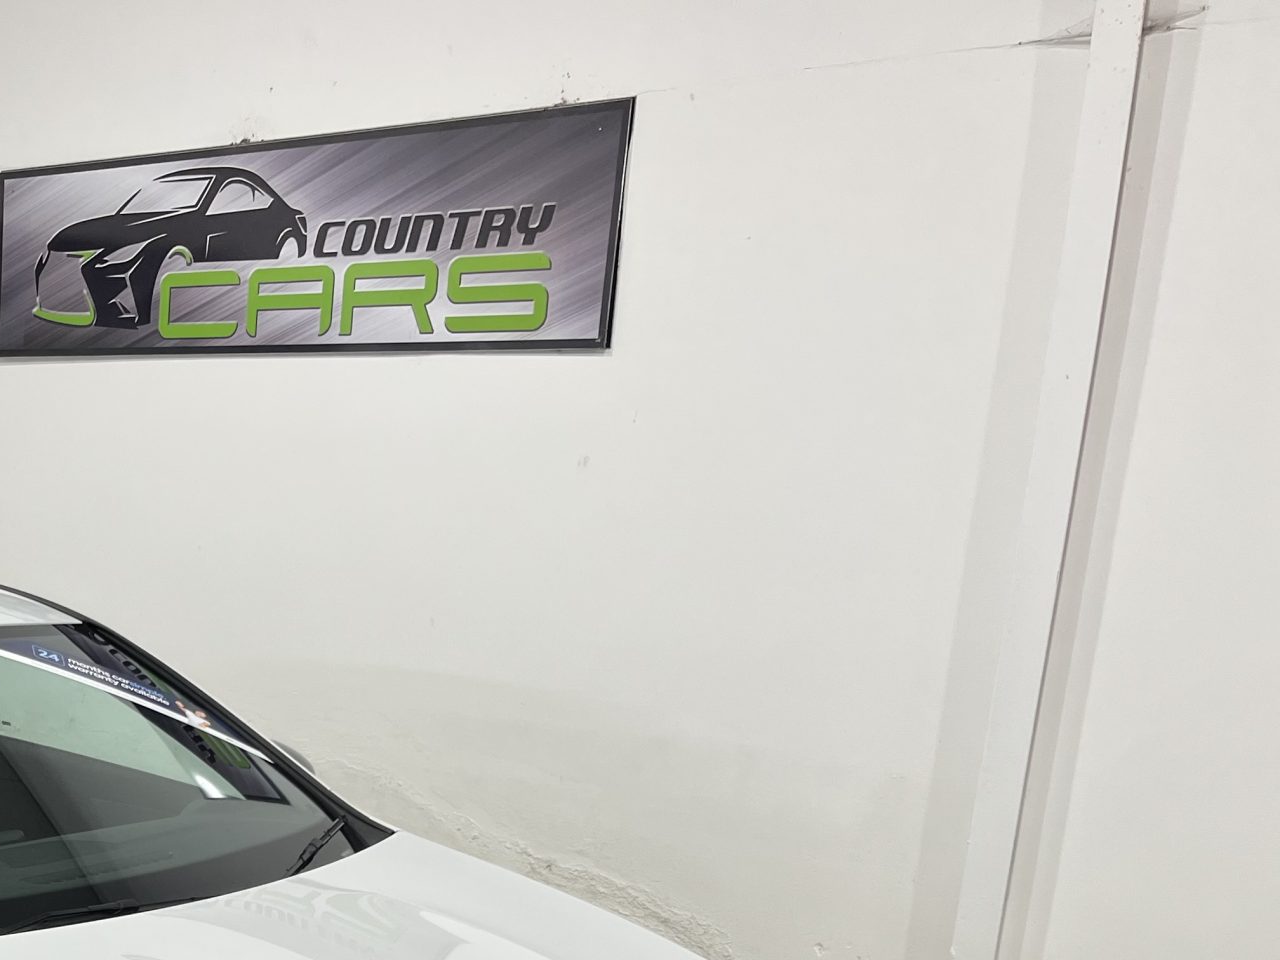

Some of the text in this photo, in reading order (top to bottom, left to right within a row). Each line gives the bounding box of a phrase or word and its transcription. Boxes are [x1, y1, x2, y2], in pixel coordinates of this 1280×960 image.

[313, 204, 556, 258] COUNTRY
[158, 251, 552, 339] CARS
[38, 649, 60, 662] 24
[67, 658, 111, 678] months
[67, 663, 120, 686] warranty
[120, 682, 170, 706] available
